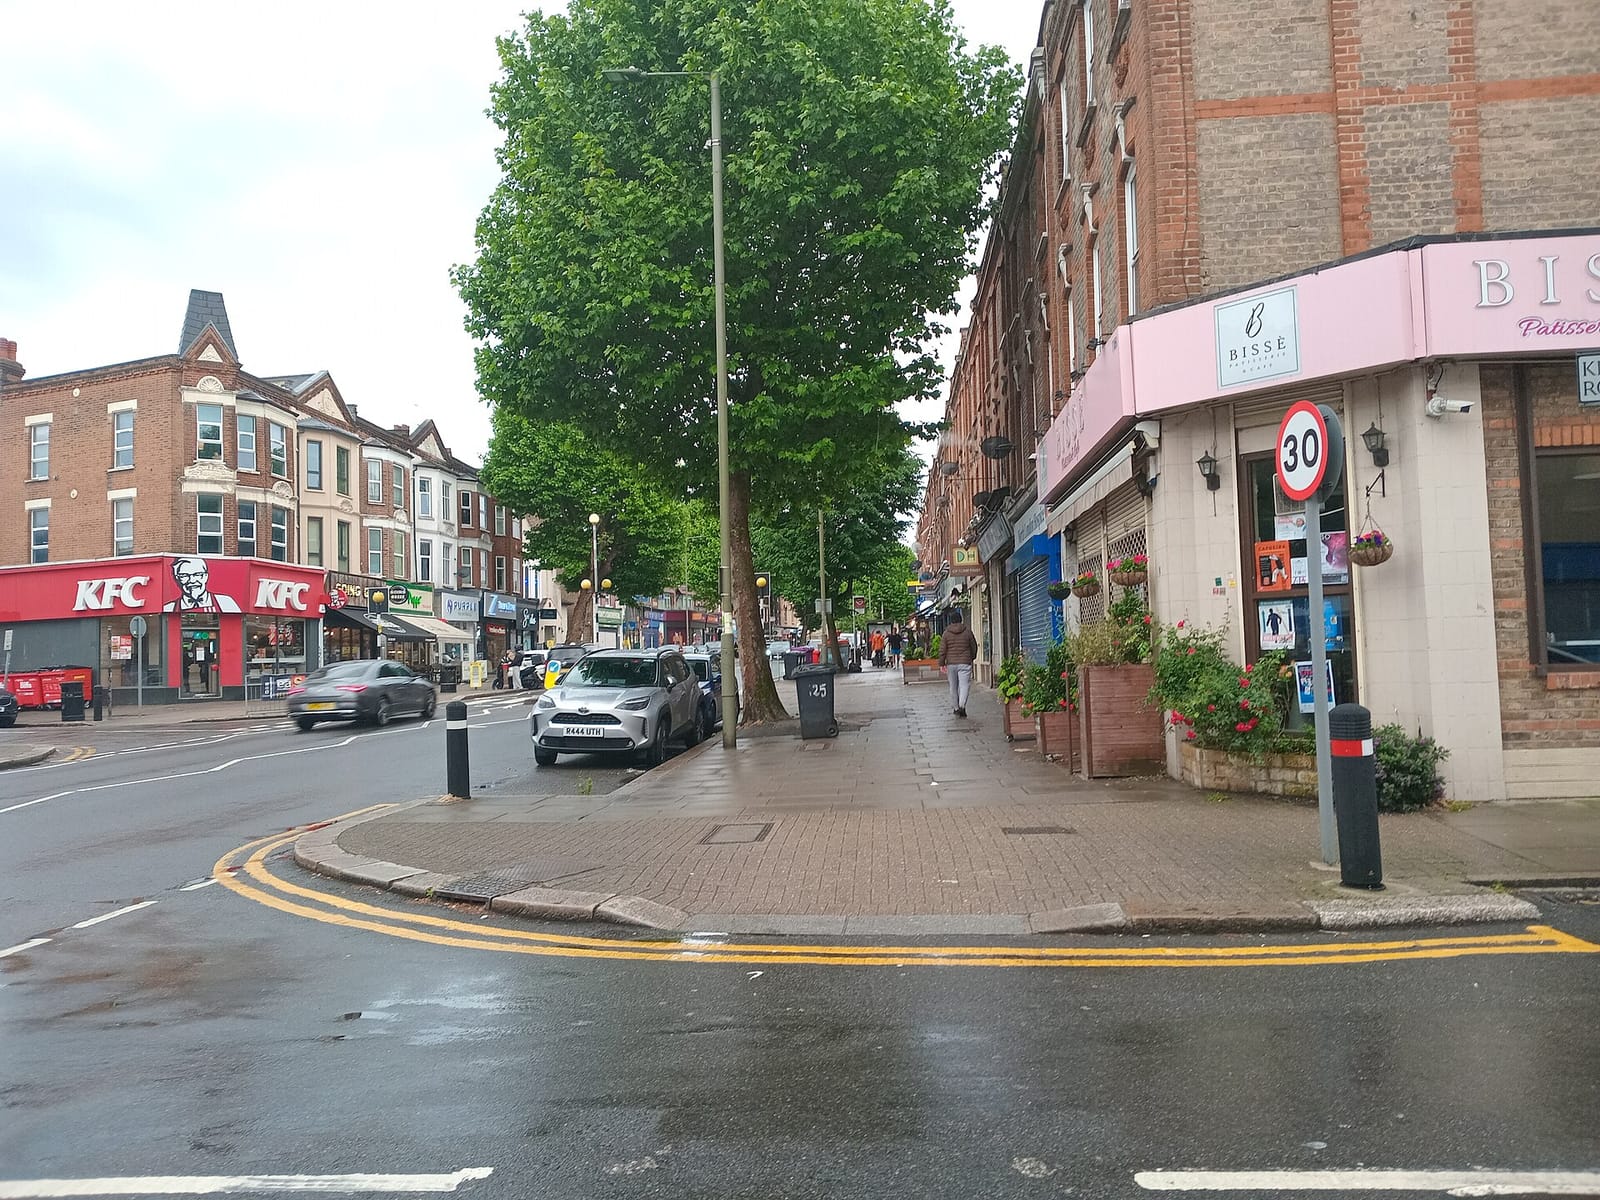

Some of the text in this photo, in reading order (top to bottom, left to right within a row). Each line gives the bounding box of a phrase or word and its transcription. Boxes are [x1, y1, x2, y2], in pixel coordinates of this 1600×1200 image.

[1283, 428, 1320, 473] 30
[72, 576, 150, 611] KFC
[254, 578, 311, 611] KFC
[565, 727, 601, 736] R444 UTH
